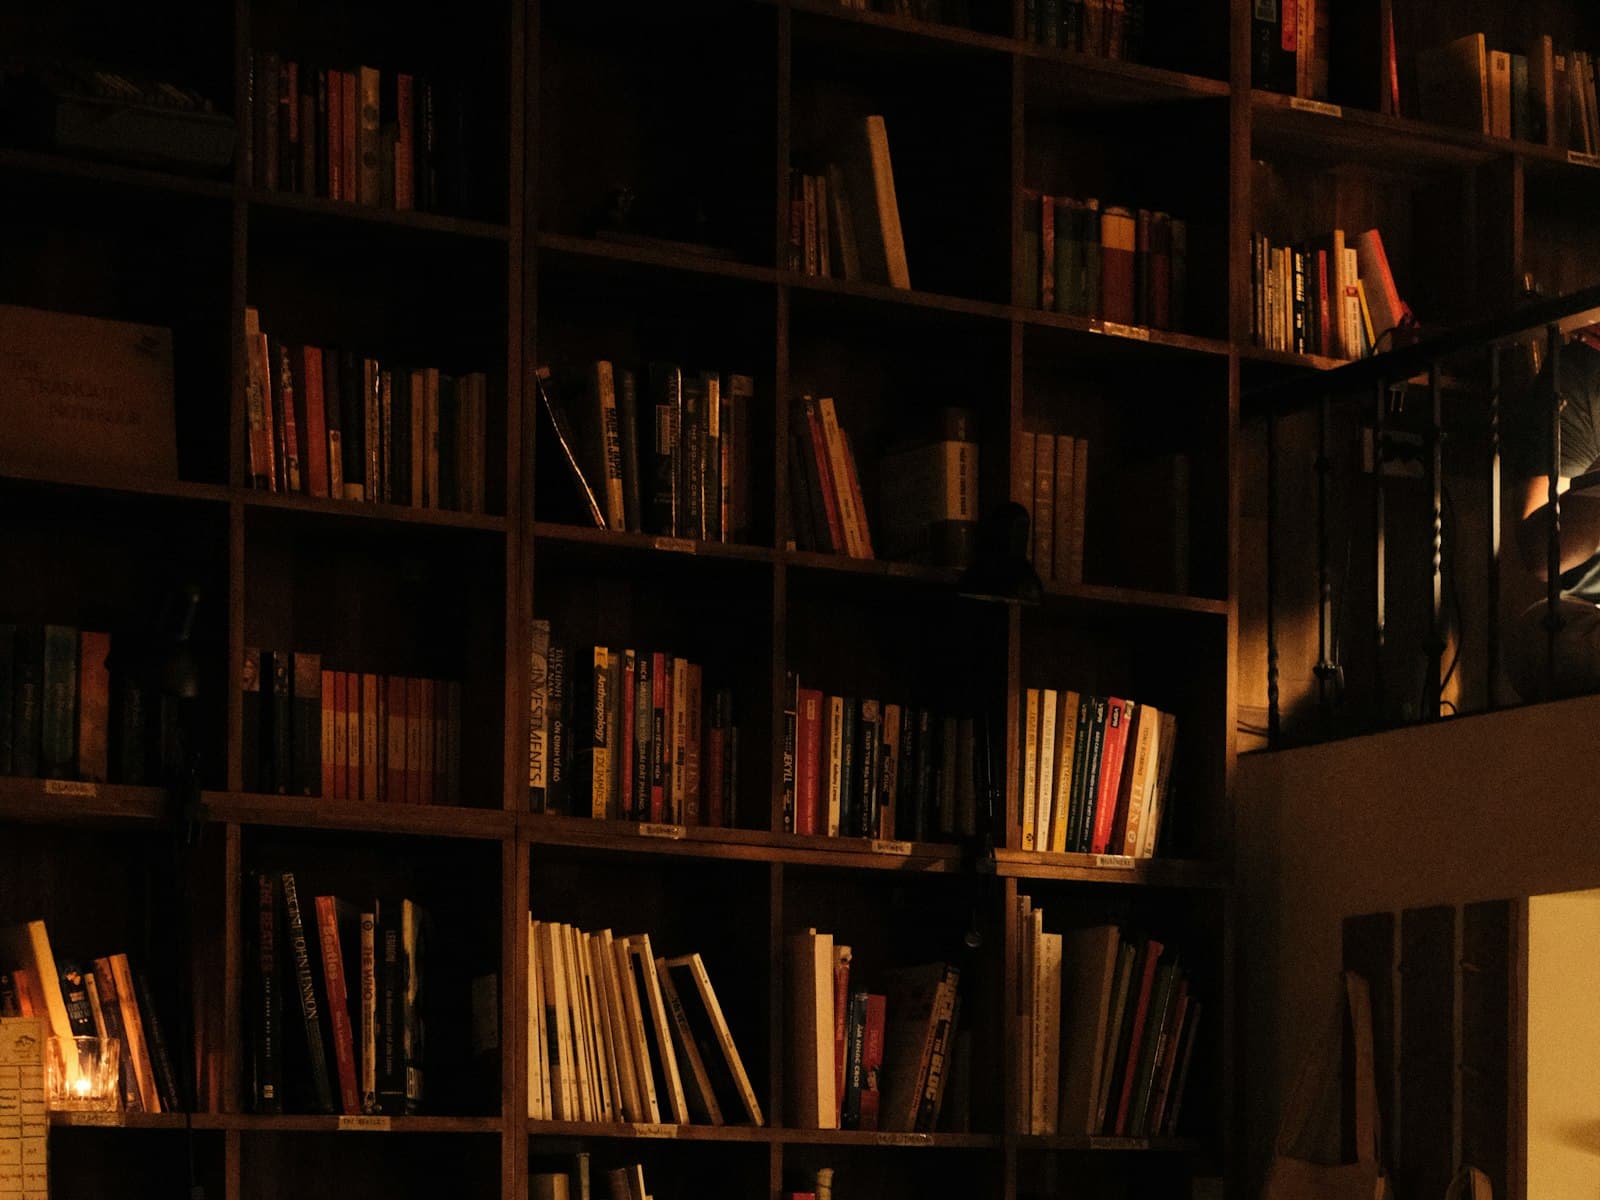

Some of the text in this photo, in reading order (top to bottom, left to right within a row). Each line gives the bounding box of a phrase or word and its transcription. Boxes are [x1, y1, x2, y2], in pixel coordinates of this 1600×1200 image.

[595, 673, 607, 743] Anthropology
[1111, 707, 1120, 728] VEPR
[529, 668, 544, 782] INVESTMENTS
[783, 752, 793, 783] JEKYLL
[293, 935, 310, 967] JOHN
[299, 969, 319, 1020] LENNON
[363, 968, 373, 1001] WHO
